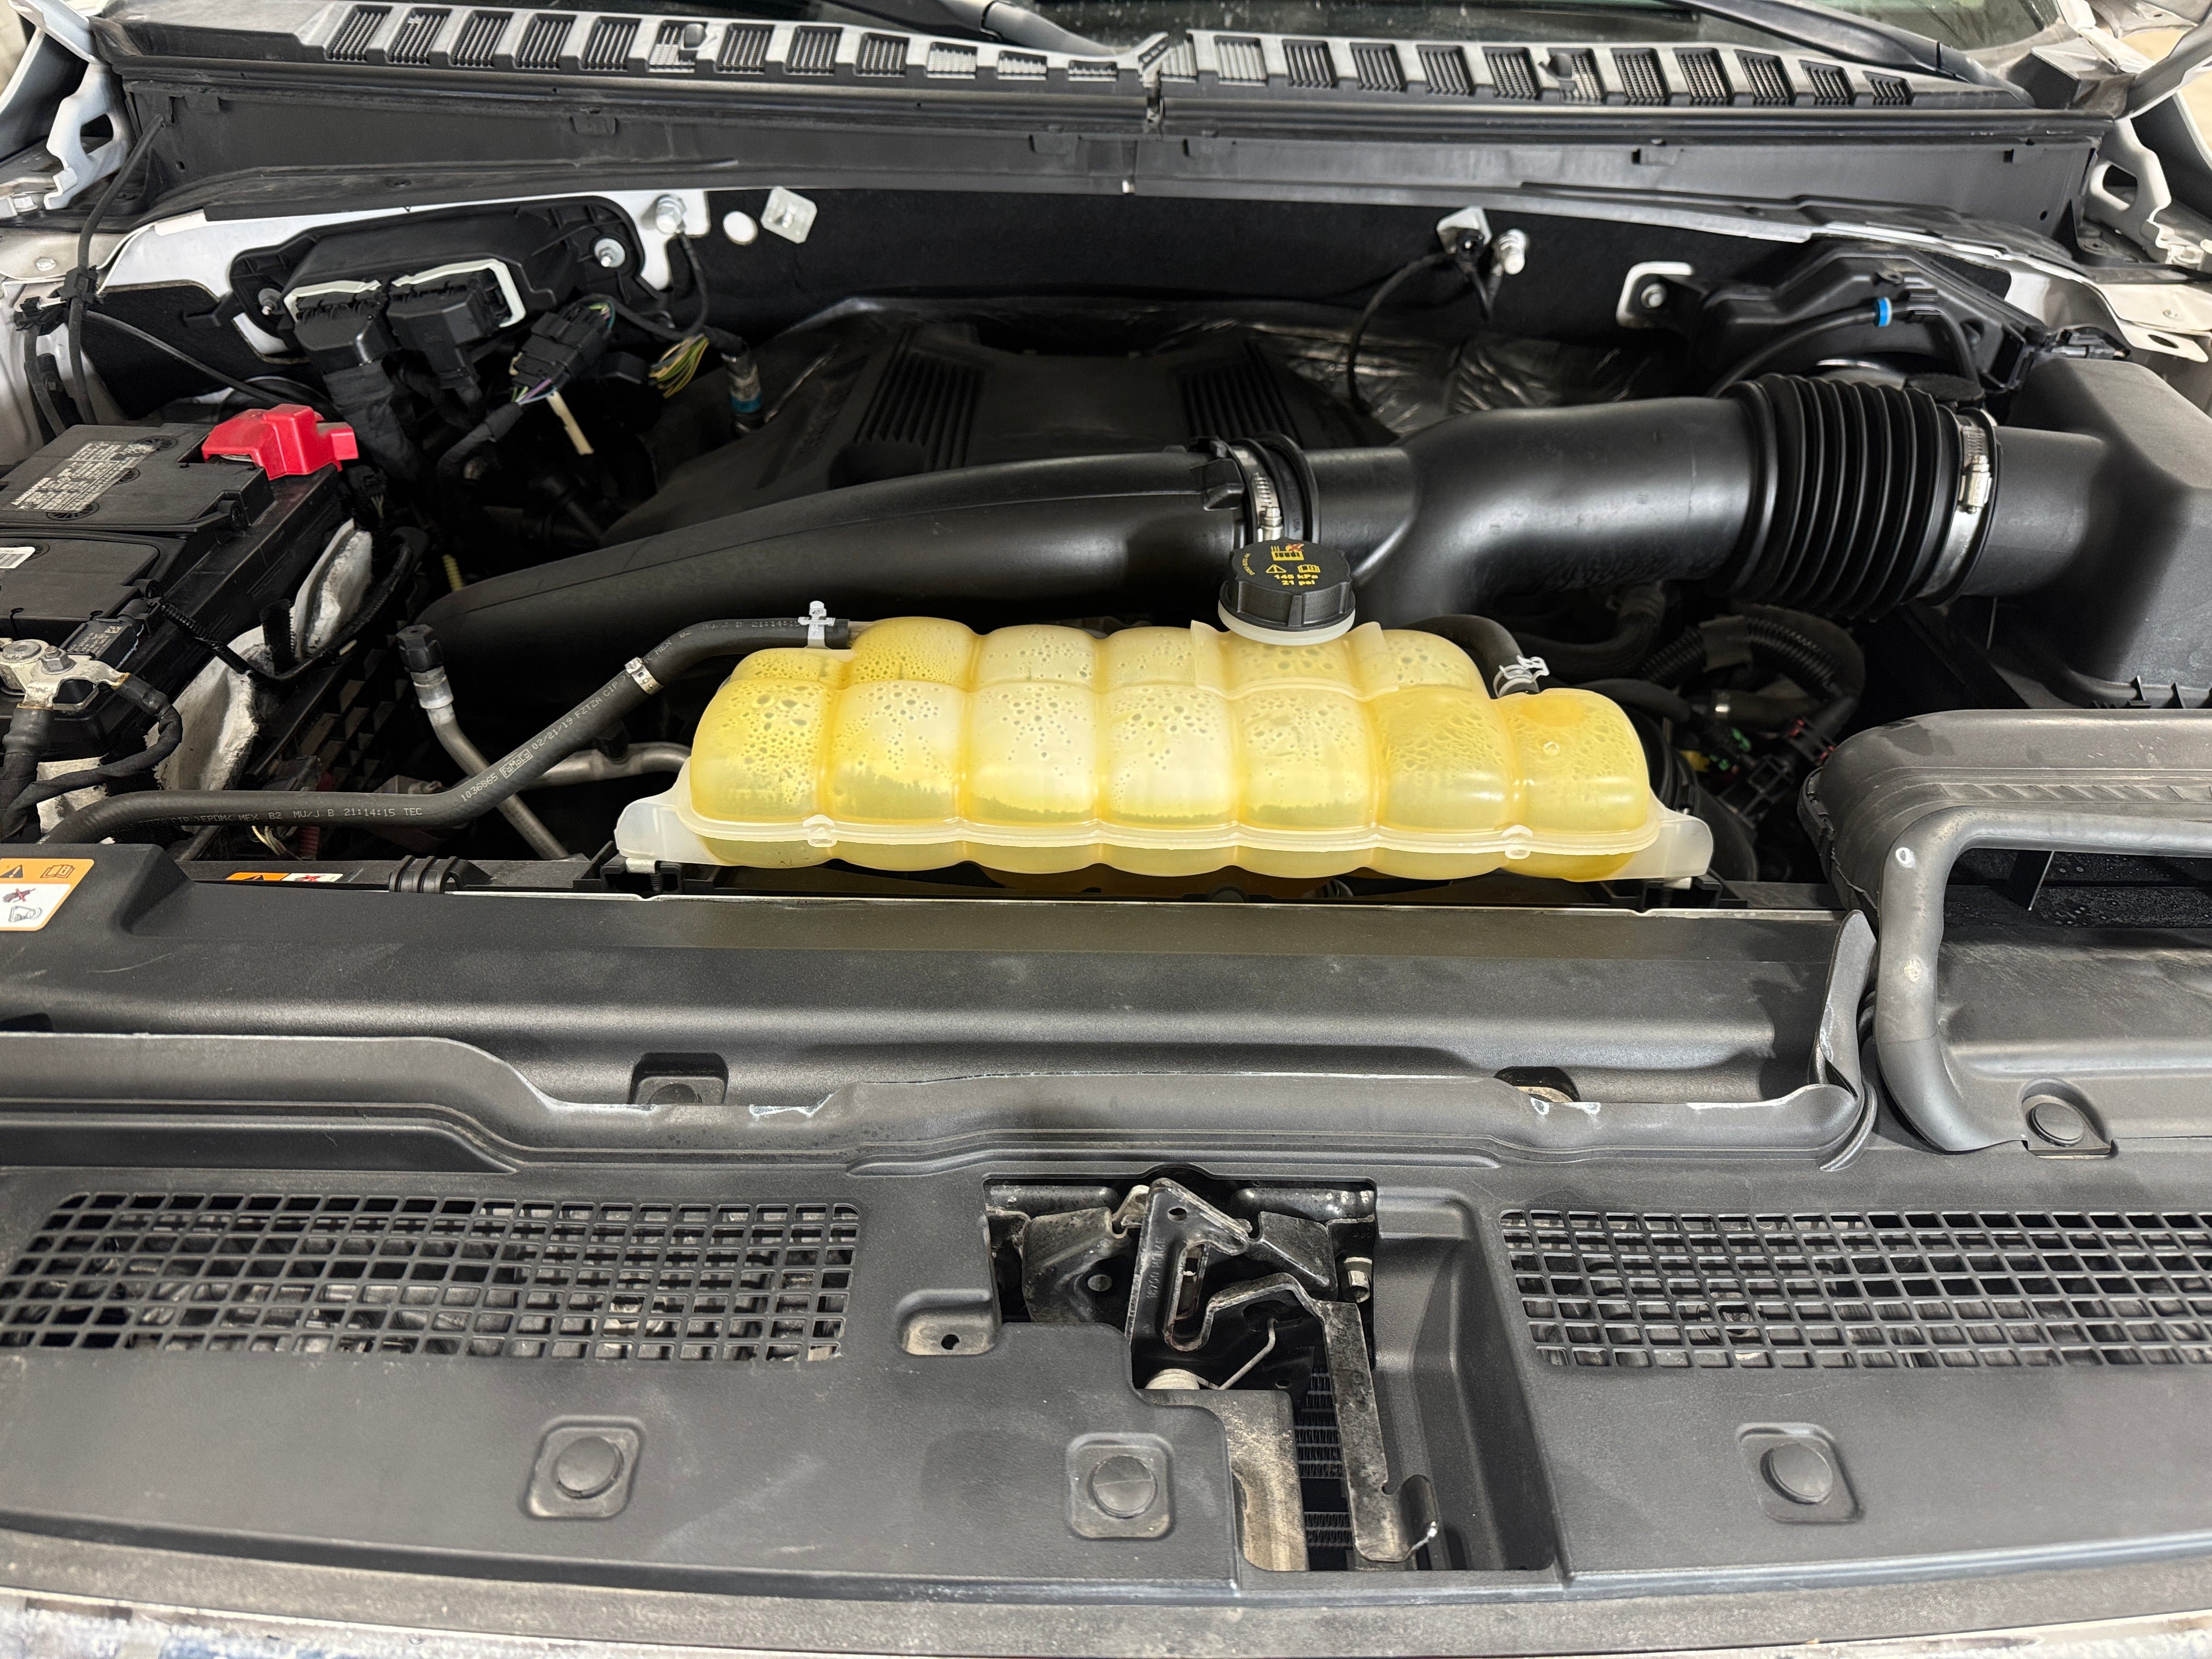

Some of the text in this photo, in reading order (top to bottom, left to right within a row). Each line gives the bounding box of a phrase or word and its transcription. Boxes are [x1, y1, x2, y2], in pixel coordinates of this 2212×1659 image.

[461, 772, 499, 802] 1036865
[532, 717, 573, 749] 02/21/19
[654, 640, 673, 656] MEX
[238, 813, 259, 822] MEX
[268, 811, 282, 820] B2
[327, 808, 335, 817] B
[343, 808, 396, 817] 21:14:15
[403, 807, 423, 816] TEC
